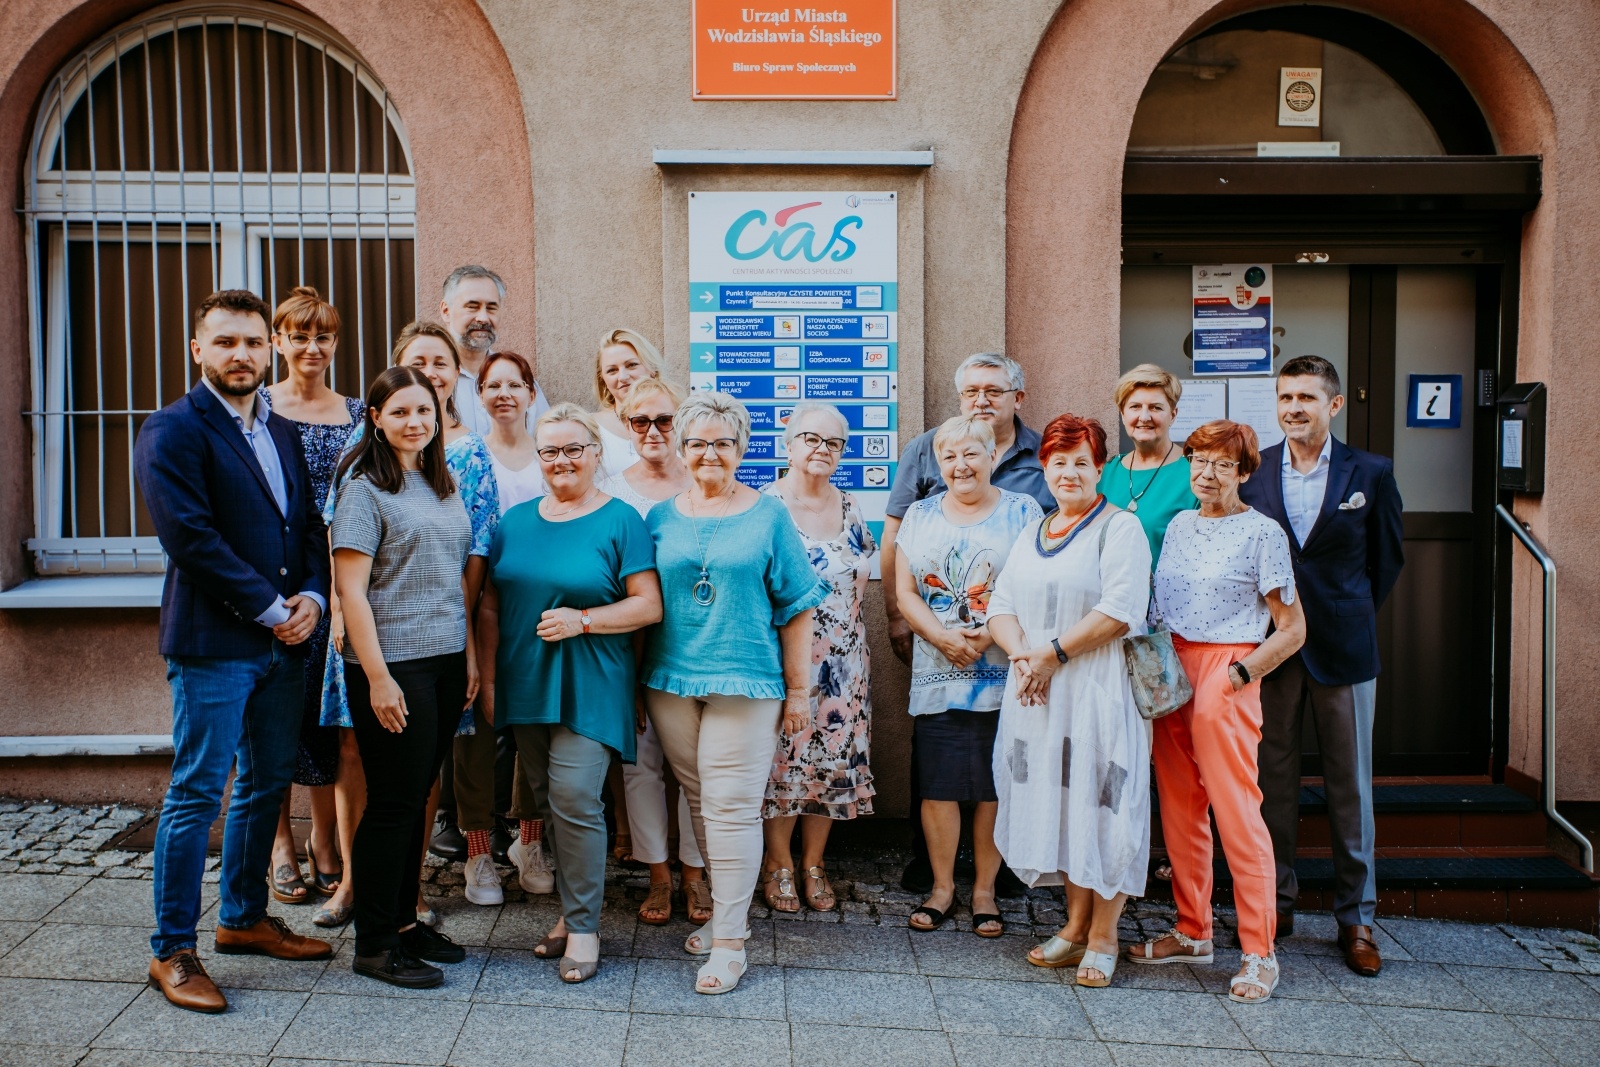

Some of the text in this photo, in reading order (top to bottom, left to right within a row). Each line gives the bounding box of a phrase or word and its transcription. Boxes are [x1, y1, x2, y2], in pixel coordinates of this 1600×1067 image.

[741, 8, 848, 26] Urząd Miasta
[707, 25, 882, 47] Wodzisławia Śląskiego
[732, 62, 857, 74] Biuro Spraw Społecznych
[765, 266, 811, 275] AKTYWNOŚCI
[745, 290, 788, 298] Konsultacyjny
